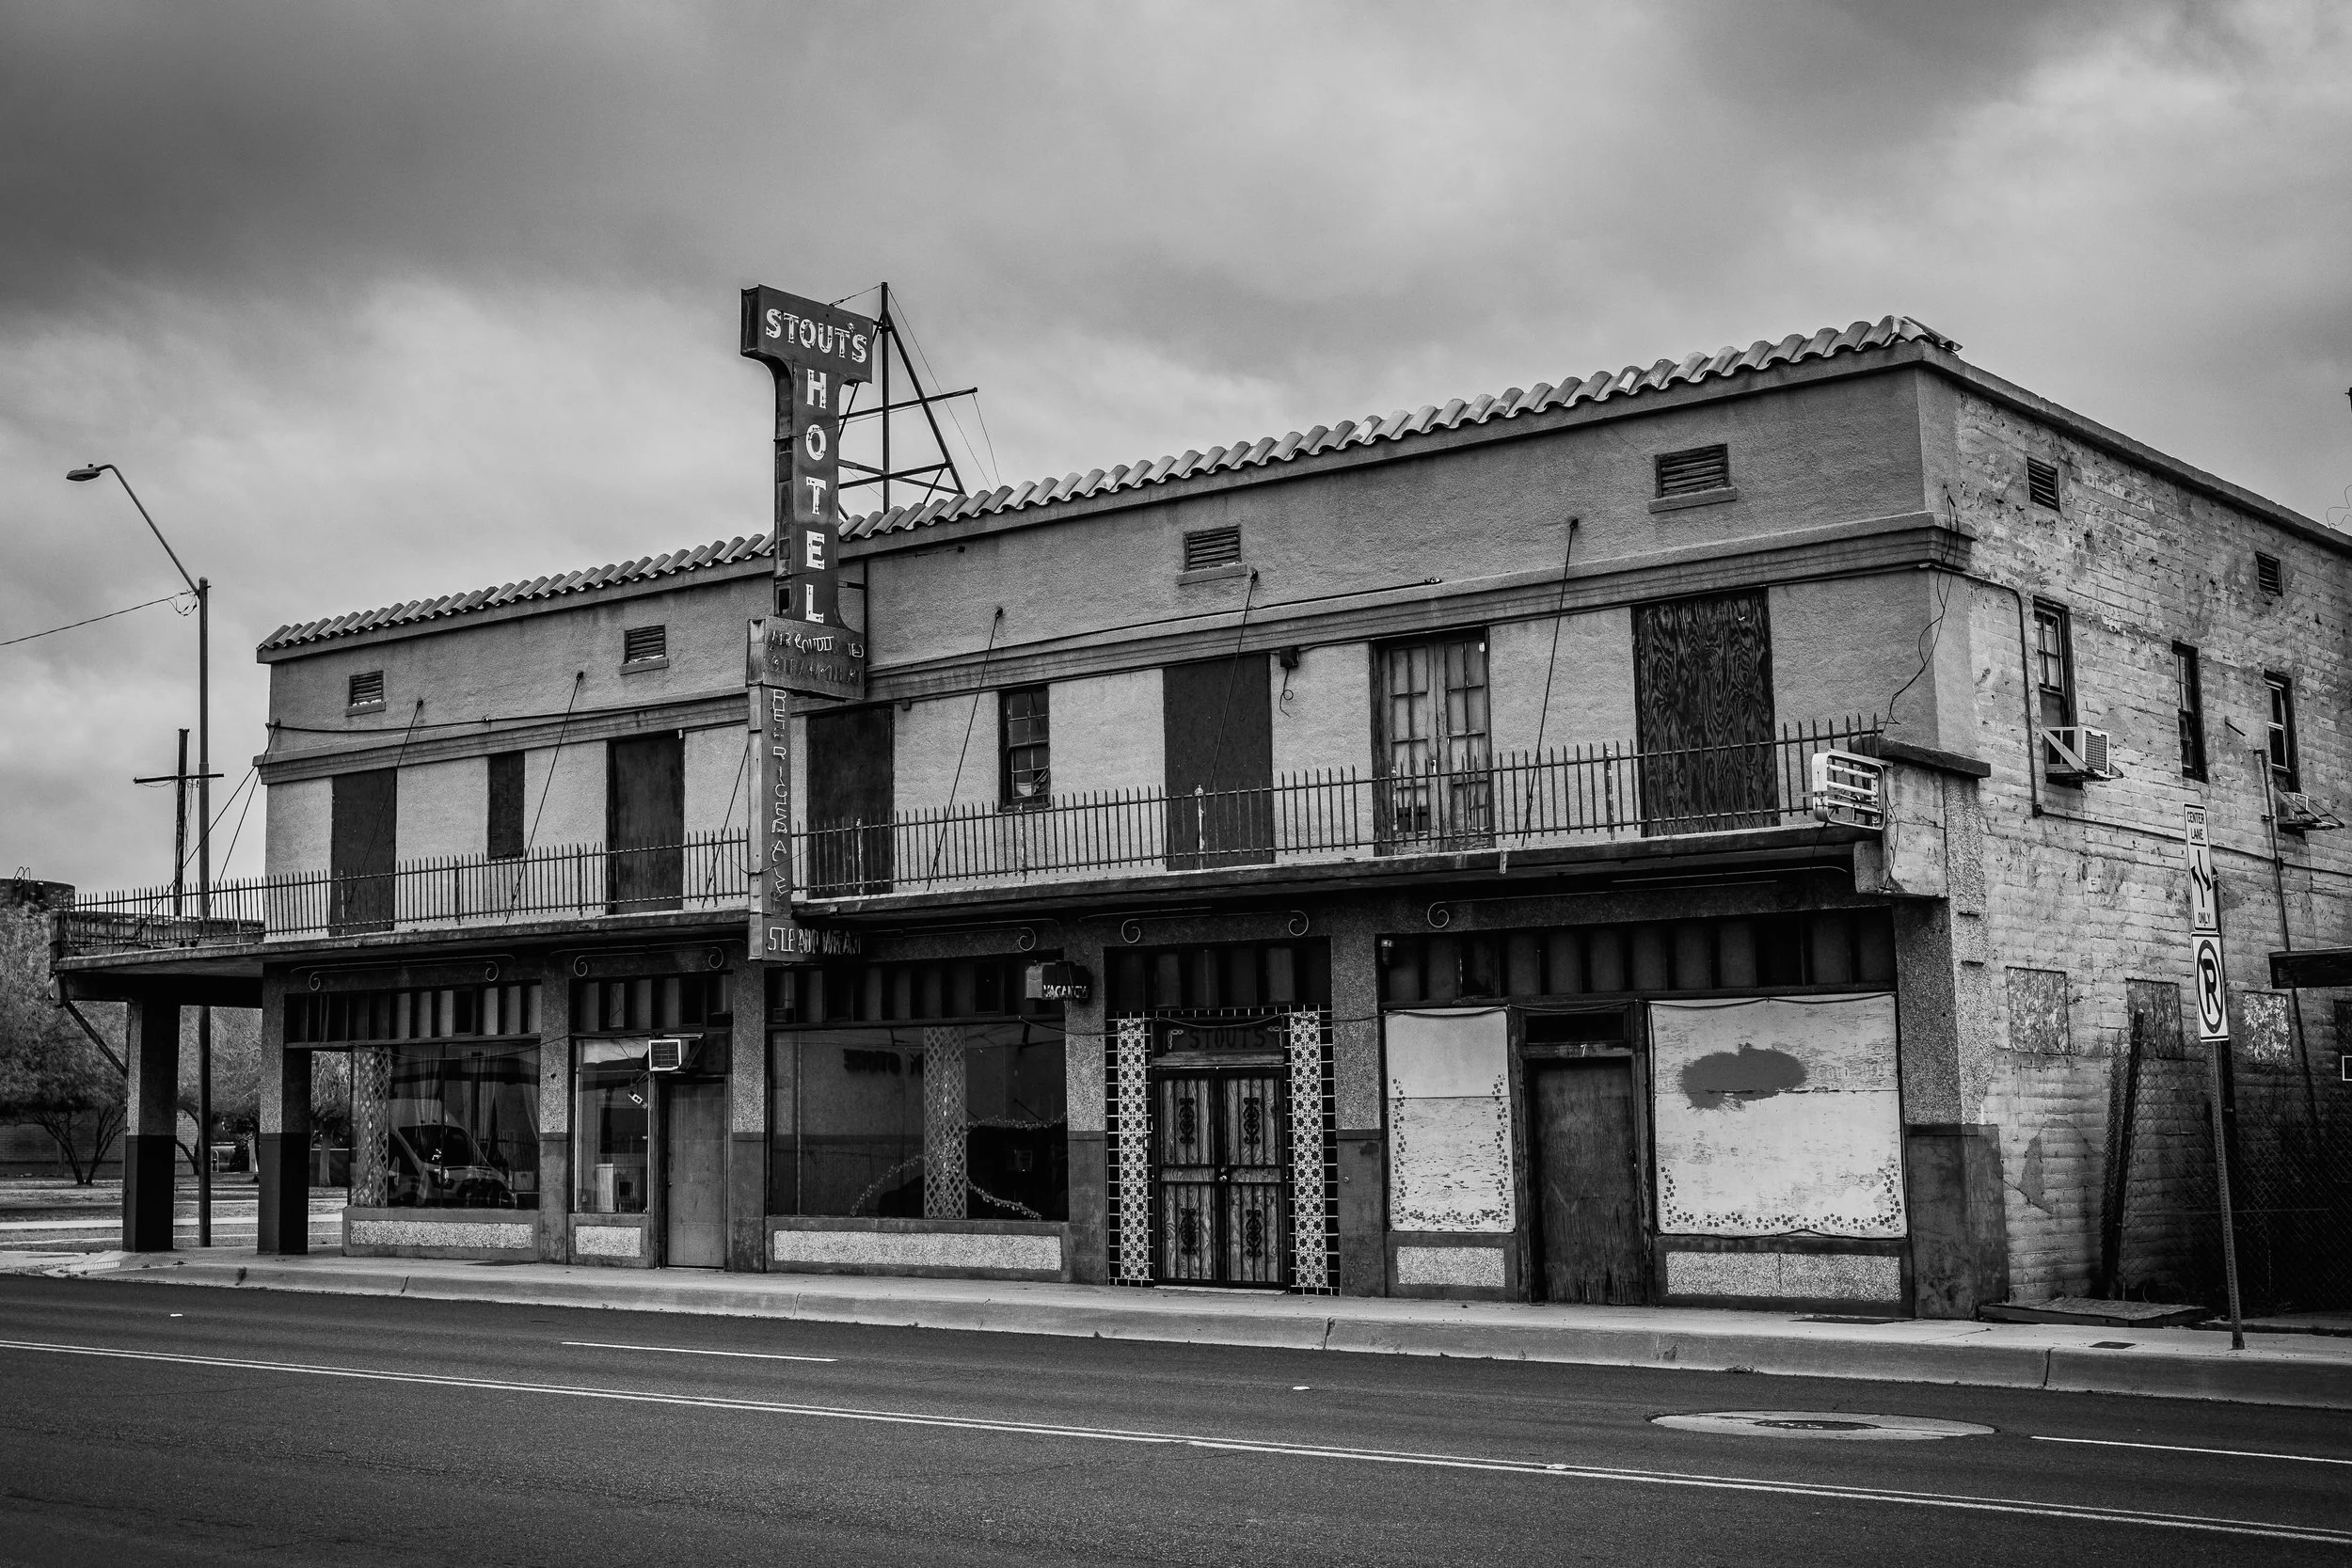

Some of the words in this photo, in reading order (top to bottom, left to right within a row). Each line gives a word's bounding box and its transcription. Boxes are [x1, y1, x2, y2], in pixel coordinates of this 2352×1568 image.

[766, 309, 867, 363] STOUT'S
[805, 368, 827, 624] HOTEL
[2187, 810, 2205, 825] CENTER
[2190, 827, 2204, 841] LANE
[2198, 911, 2211, 926] ONLY
[1043, 984, 1089, 1000] VACANCY
